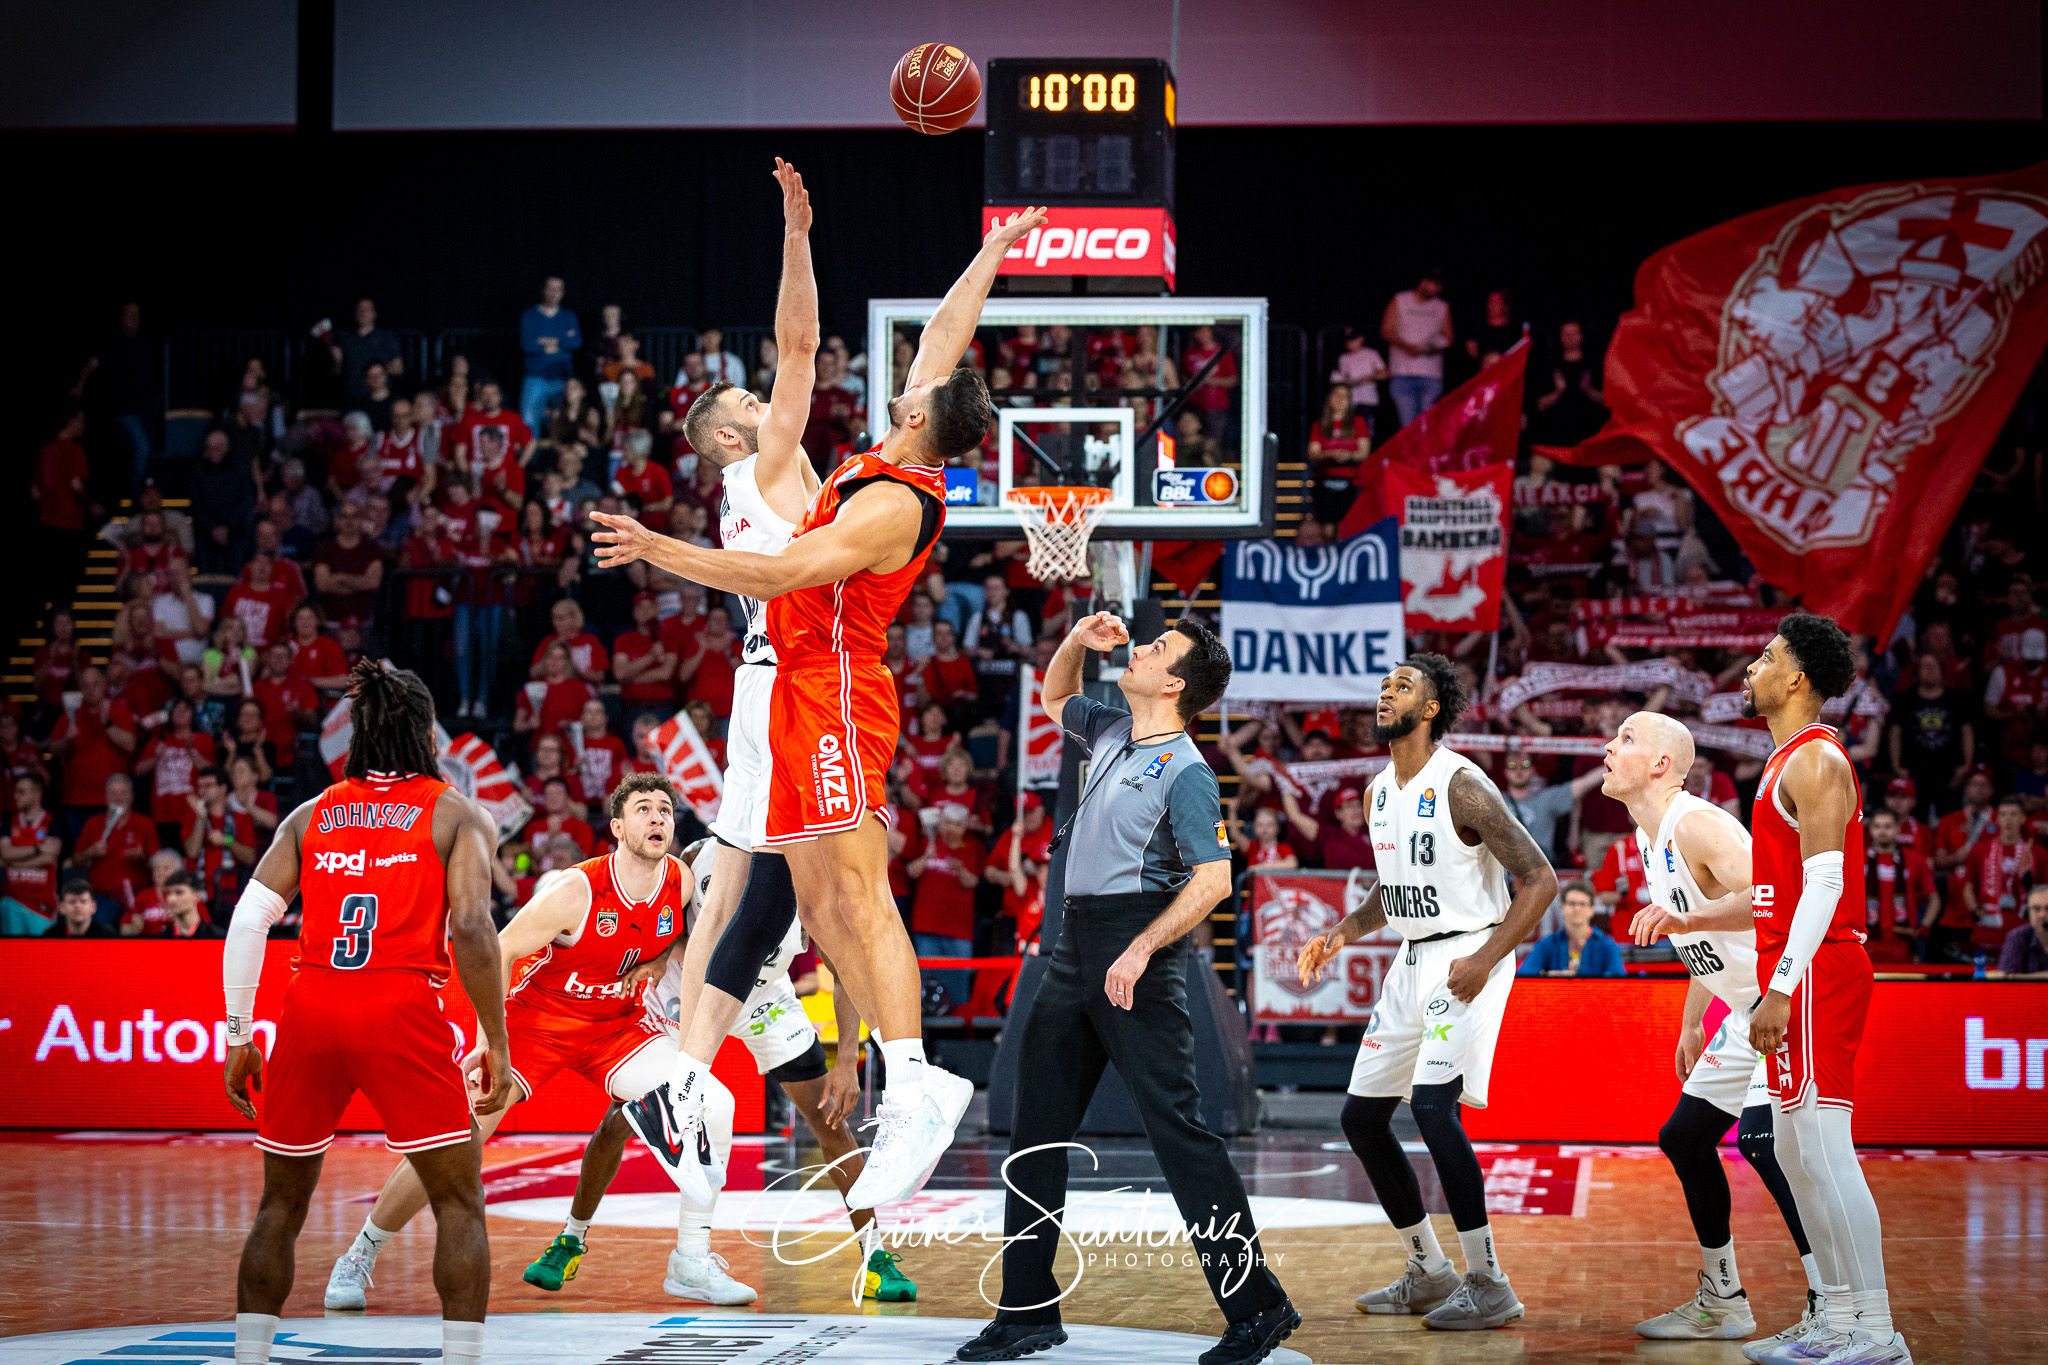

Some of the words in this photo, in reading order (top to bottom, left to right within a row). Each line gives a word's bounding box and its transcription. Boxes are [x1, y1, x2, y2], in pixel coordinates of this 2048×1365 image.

[943, 59, 958, 77] BBL
[1160, 485, 1196, 501] BBL
[1233, 628, 1391, 676] DANKE
[317, 802, 424, 834] JOHNSON
[1418, 808, 1433, 816] BBL
[1408, 830, 1437, 867] 13
[314, 849, 366, 874] xpd
[375, 852, 418, 867] logistics
[344, 869, 364, 877] global
[1380, 884, 1441, 919] OWERS
[330, 893, 379, 971] 3
[786, 1028, 806, 1042] CRAFT
[1426, 1060, 1449, 1068] CRAFT
[682, 1071, 697, 1095] CRAFT
[1411, 1235, 1424, 1256] CRAFT
[1484, 1236, 1493, 1260] CRAFT
[1719, 1258, 1729, 1279] CRAFT
